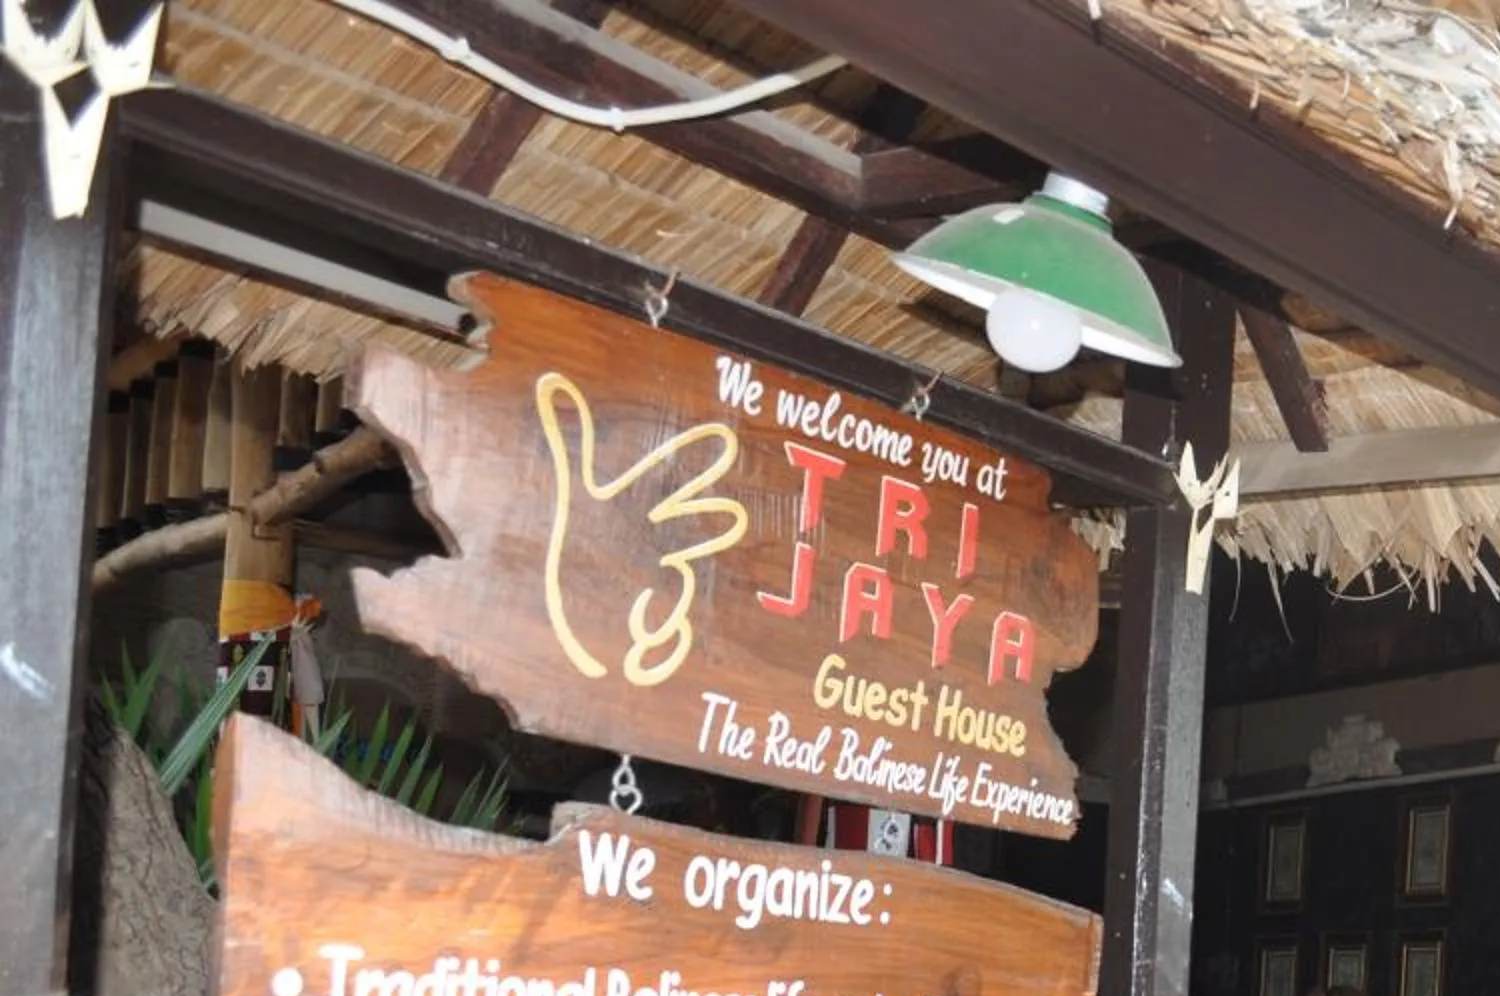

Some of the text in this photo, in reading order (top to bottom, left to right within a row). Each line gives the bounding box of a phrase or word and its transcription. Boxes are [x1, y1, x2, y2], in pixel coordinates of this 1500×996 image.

[715, 355, 1008, 500] We welcome you at
[784, 441, 978, 578] TRI
[756, 542, 1034, 686] JAYA
[697, 691, 1075, 826] The Real Balinese Life Experience
[814, 654, 1026, 756] Guest House
[573, 828, 893, 930] We organize:
